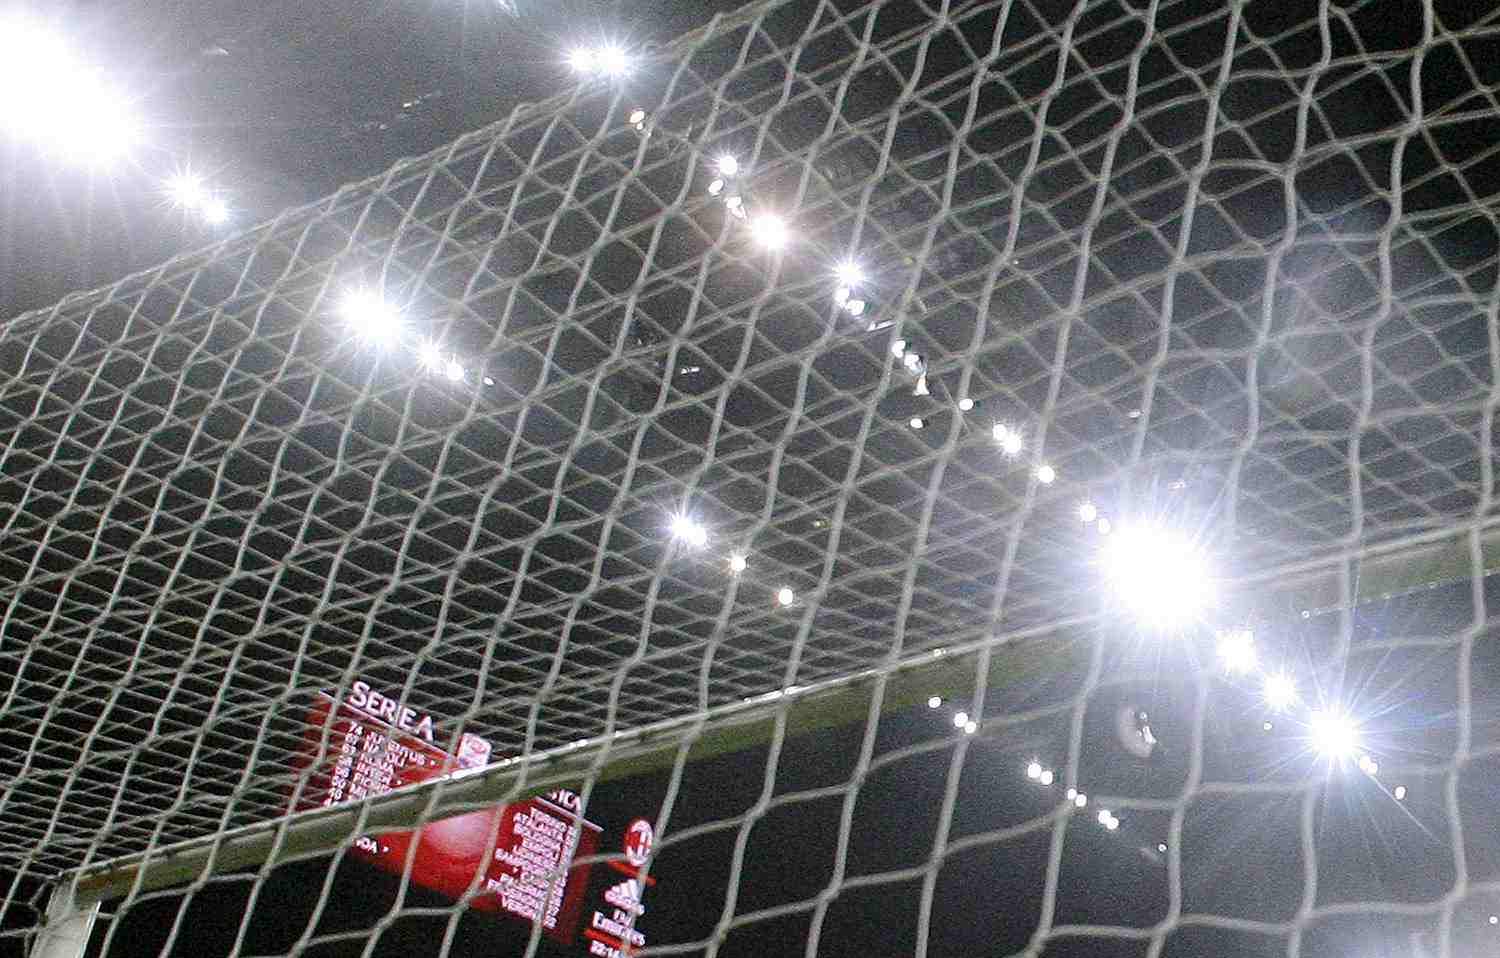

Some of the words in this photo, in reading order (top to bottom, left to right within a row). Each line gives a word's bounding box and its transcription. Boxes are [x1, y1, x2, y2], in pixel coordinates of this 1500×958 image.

[349, 680, 417, 732] SERIE
[414, 715, 435, 745] A
[366, 731, 426, 766] JUENTUS
